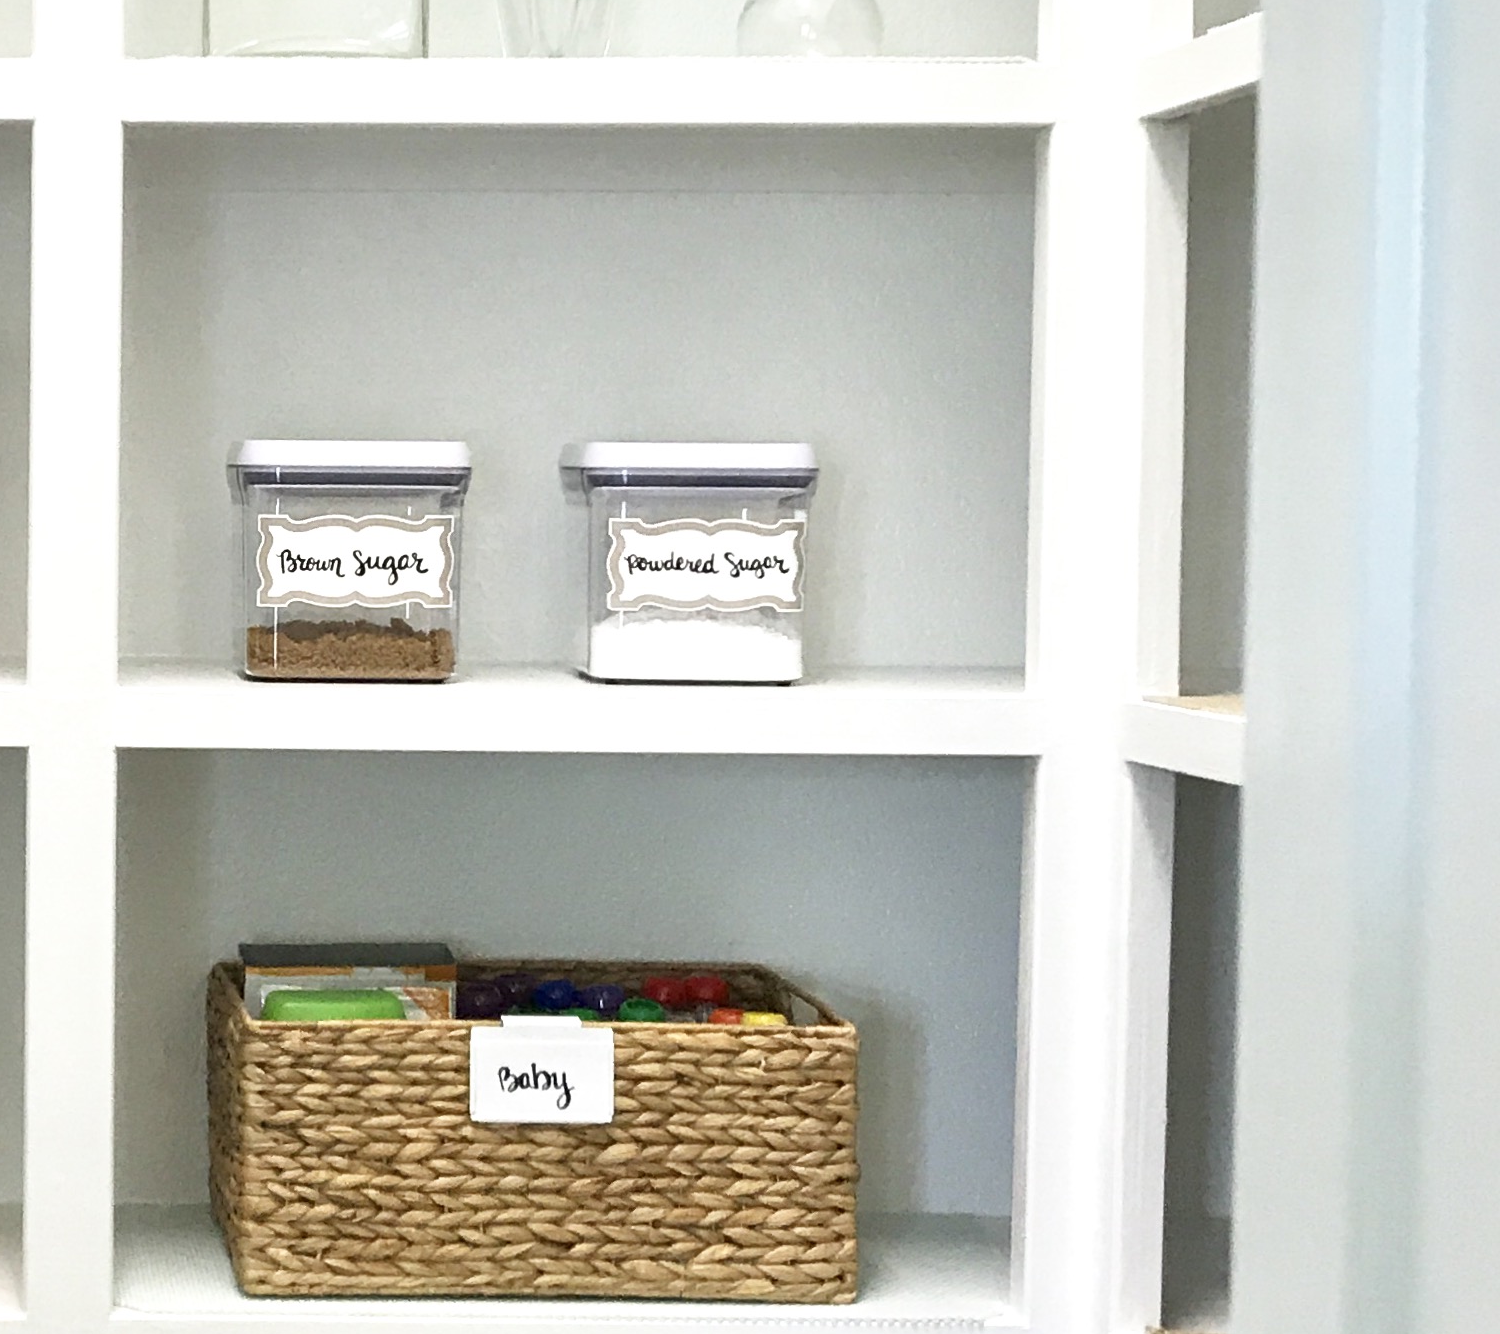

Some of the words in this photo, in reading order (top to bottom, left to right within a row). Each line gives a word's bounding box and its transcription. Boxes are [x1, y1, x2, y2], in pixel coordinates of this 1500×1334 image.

[275, 548, 343, 578] Brown
[353, 549, 429, 586] Sugar
[723, 551, 791, 580] Sugar
[497, 1061, 576, 1110] Baby
